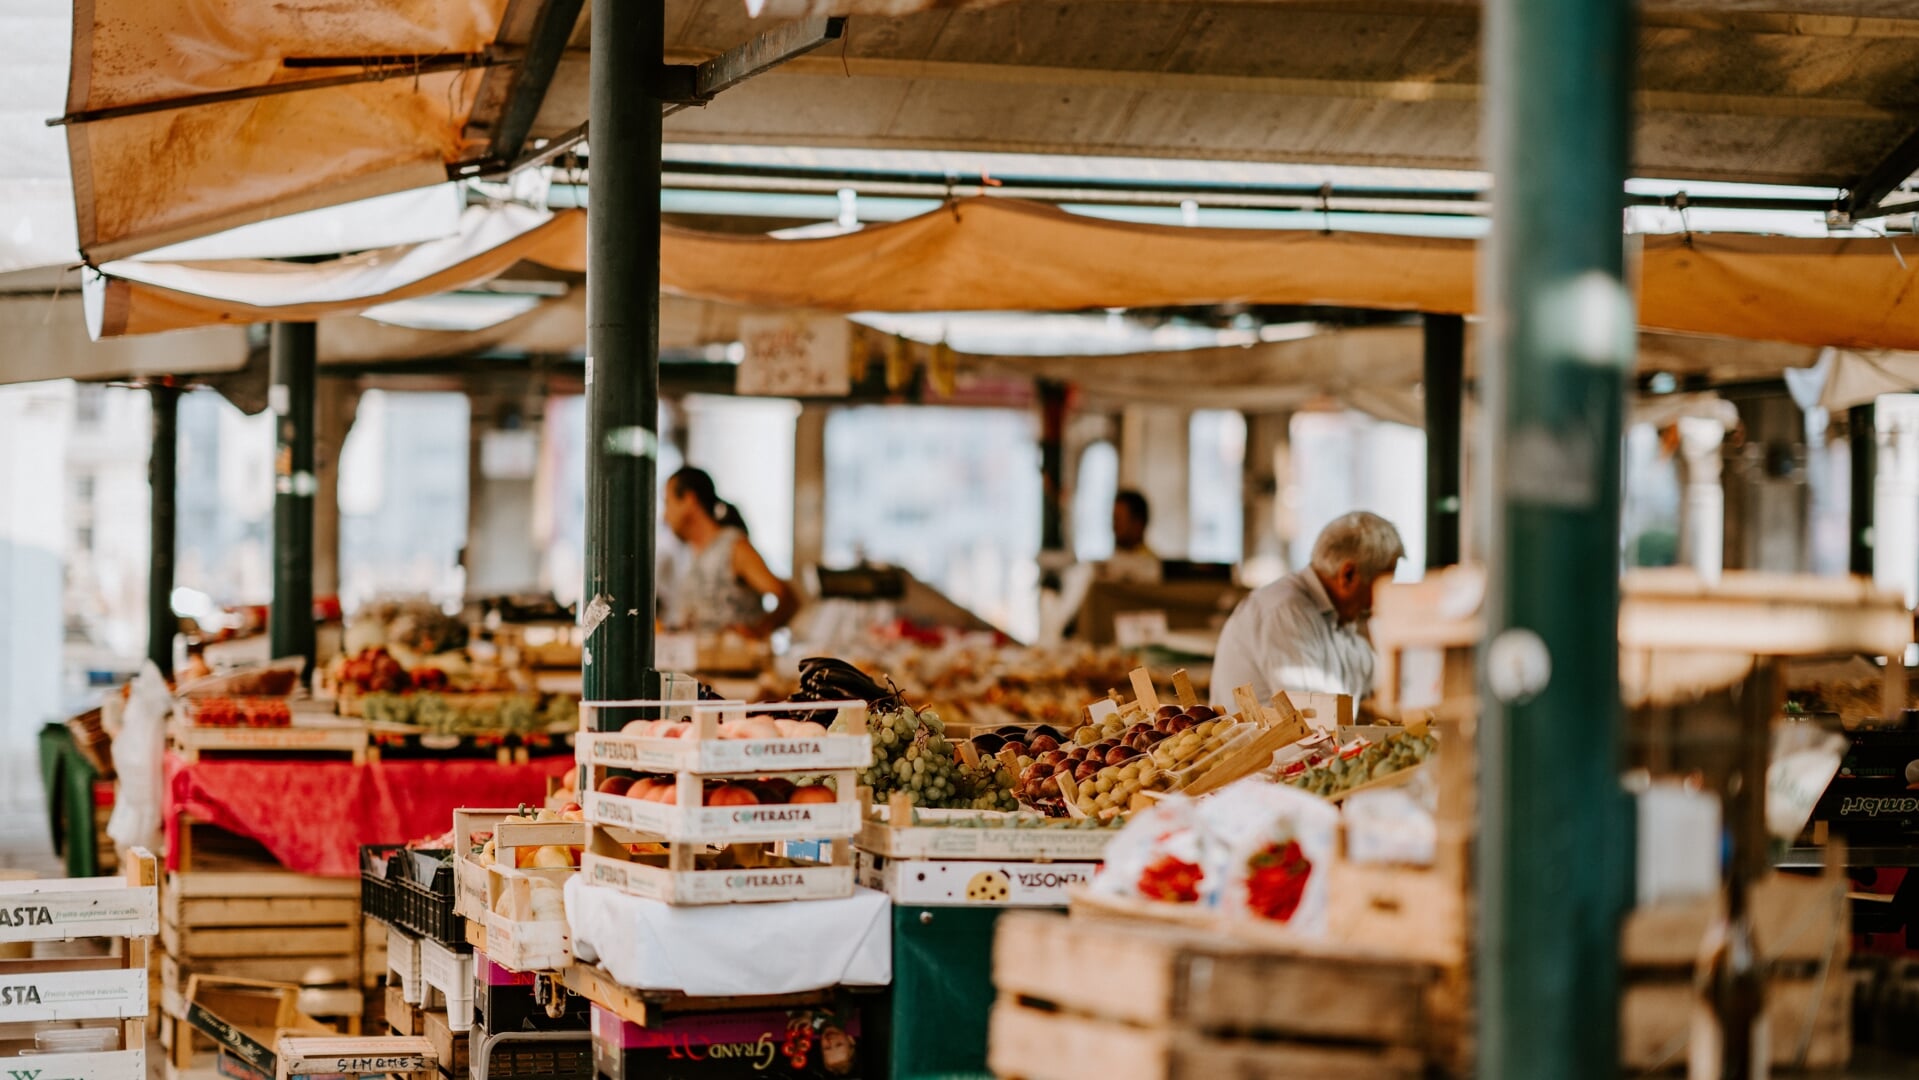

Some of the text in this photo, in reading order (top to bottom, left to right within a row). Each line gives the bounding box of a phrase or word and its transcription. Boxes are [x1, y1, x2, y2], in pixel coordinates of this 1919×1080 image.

[744, 743, 820, 757] COFERASTA
[732, 809, 811, 823] COFERASTA
[726, 874, 804, 888] COFERASTA
[0, 985, 41, 1005] STA
